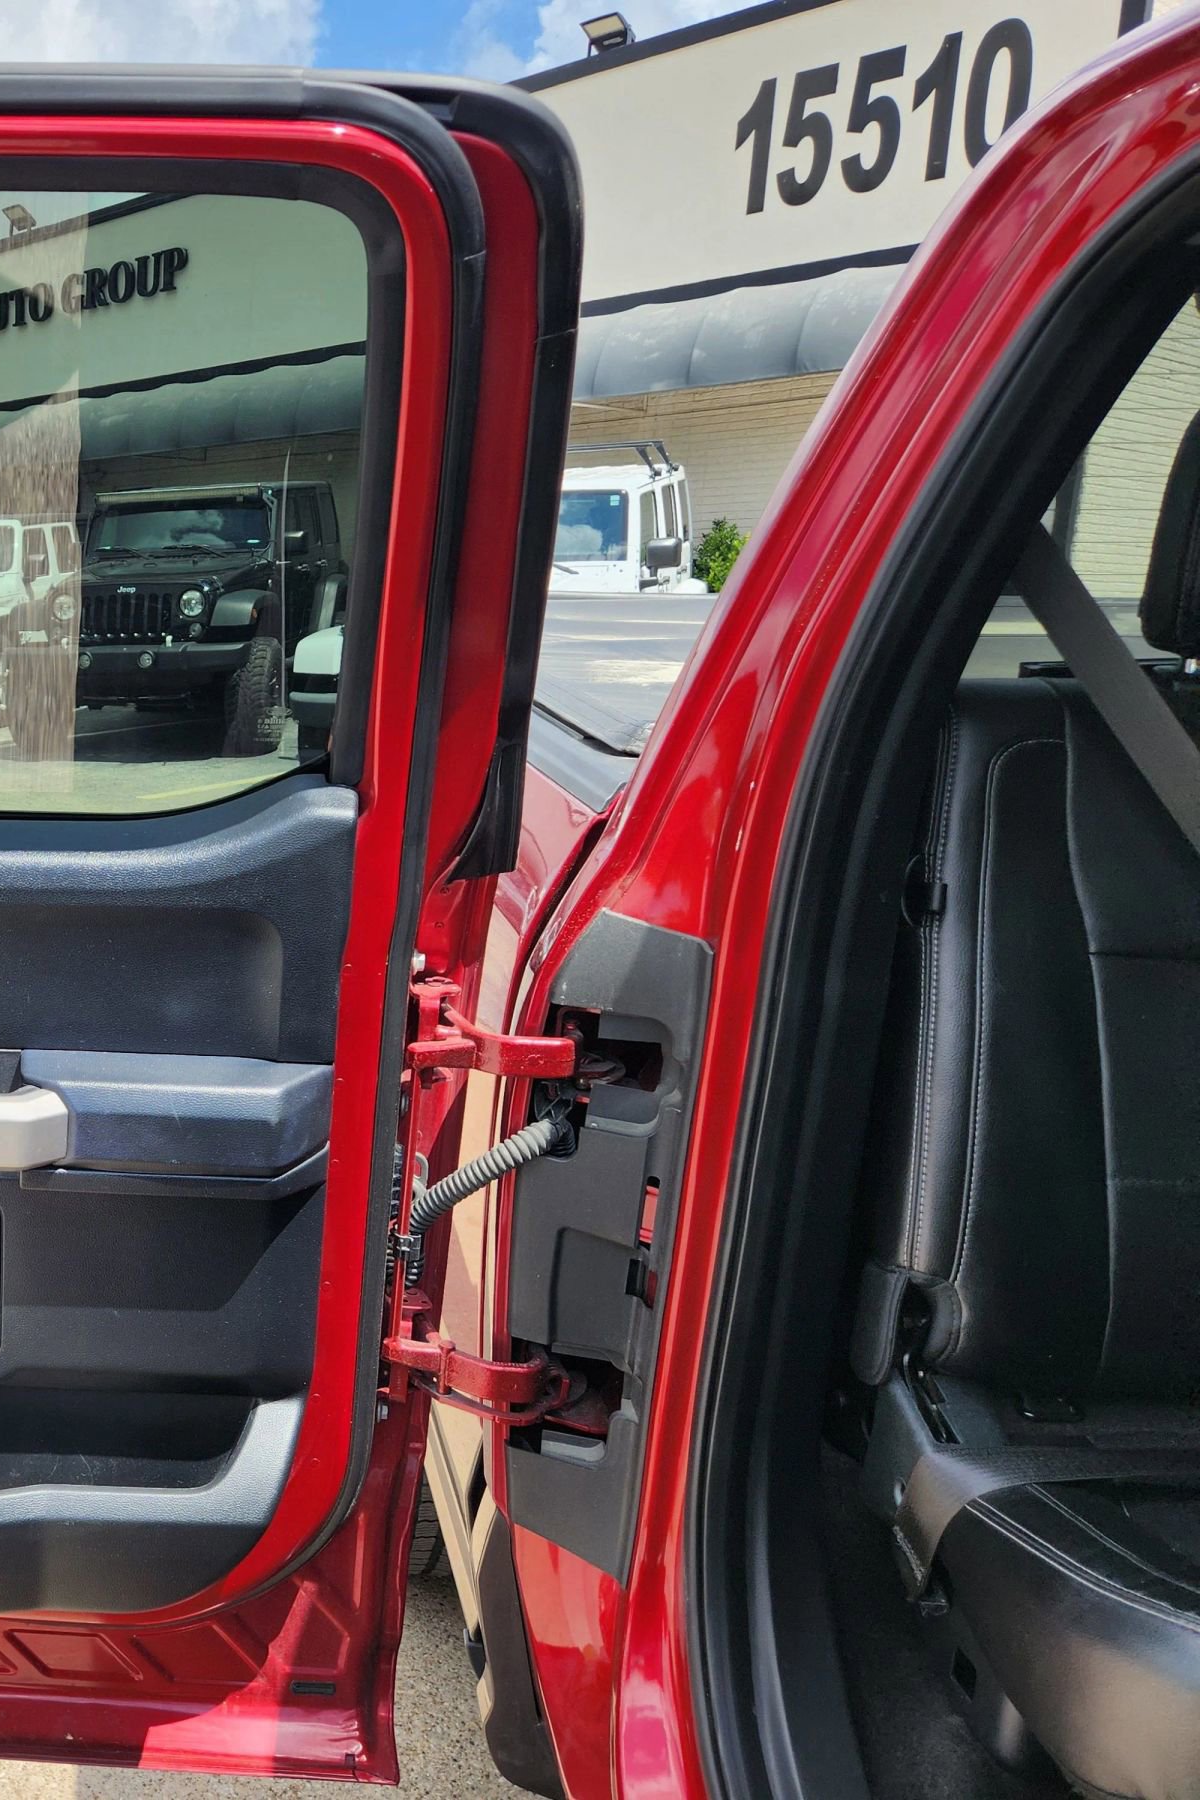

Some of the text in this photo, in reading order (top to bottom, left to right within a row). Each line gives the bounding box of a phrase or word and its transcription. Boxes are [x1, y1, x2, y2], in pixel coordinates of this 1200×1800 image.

[735, 18, 1033, 215] 15510
[61, 247, 188, 313] GROUP
[117, 586, 136, 594] Jeep
